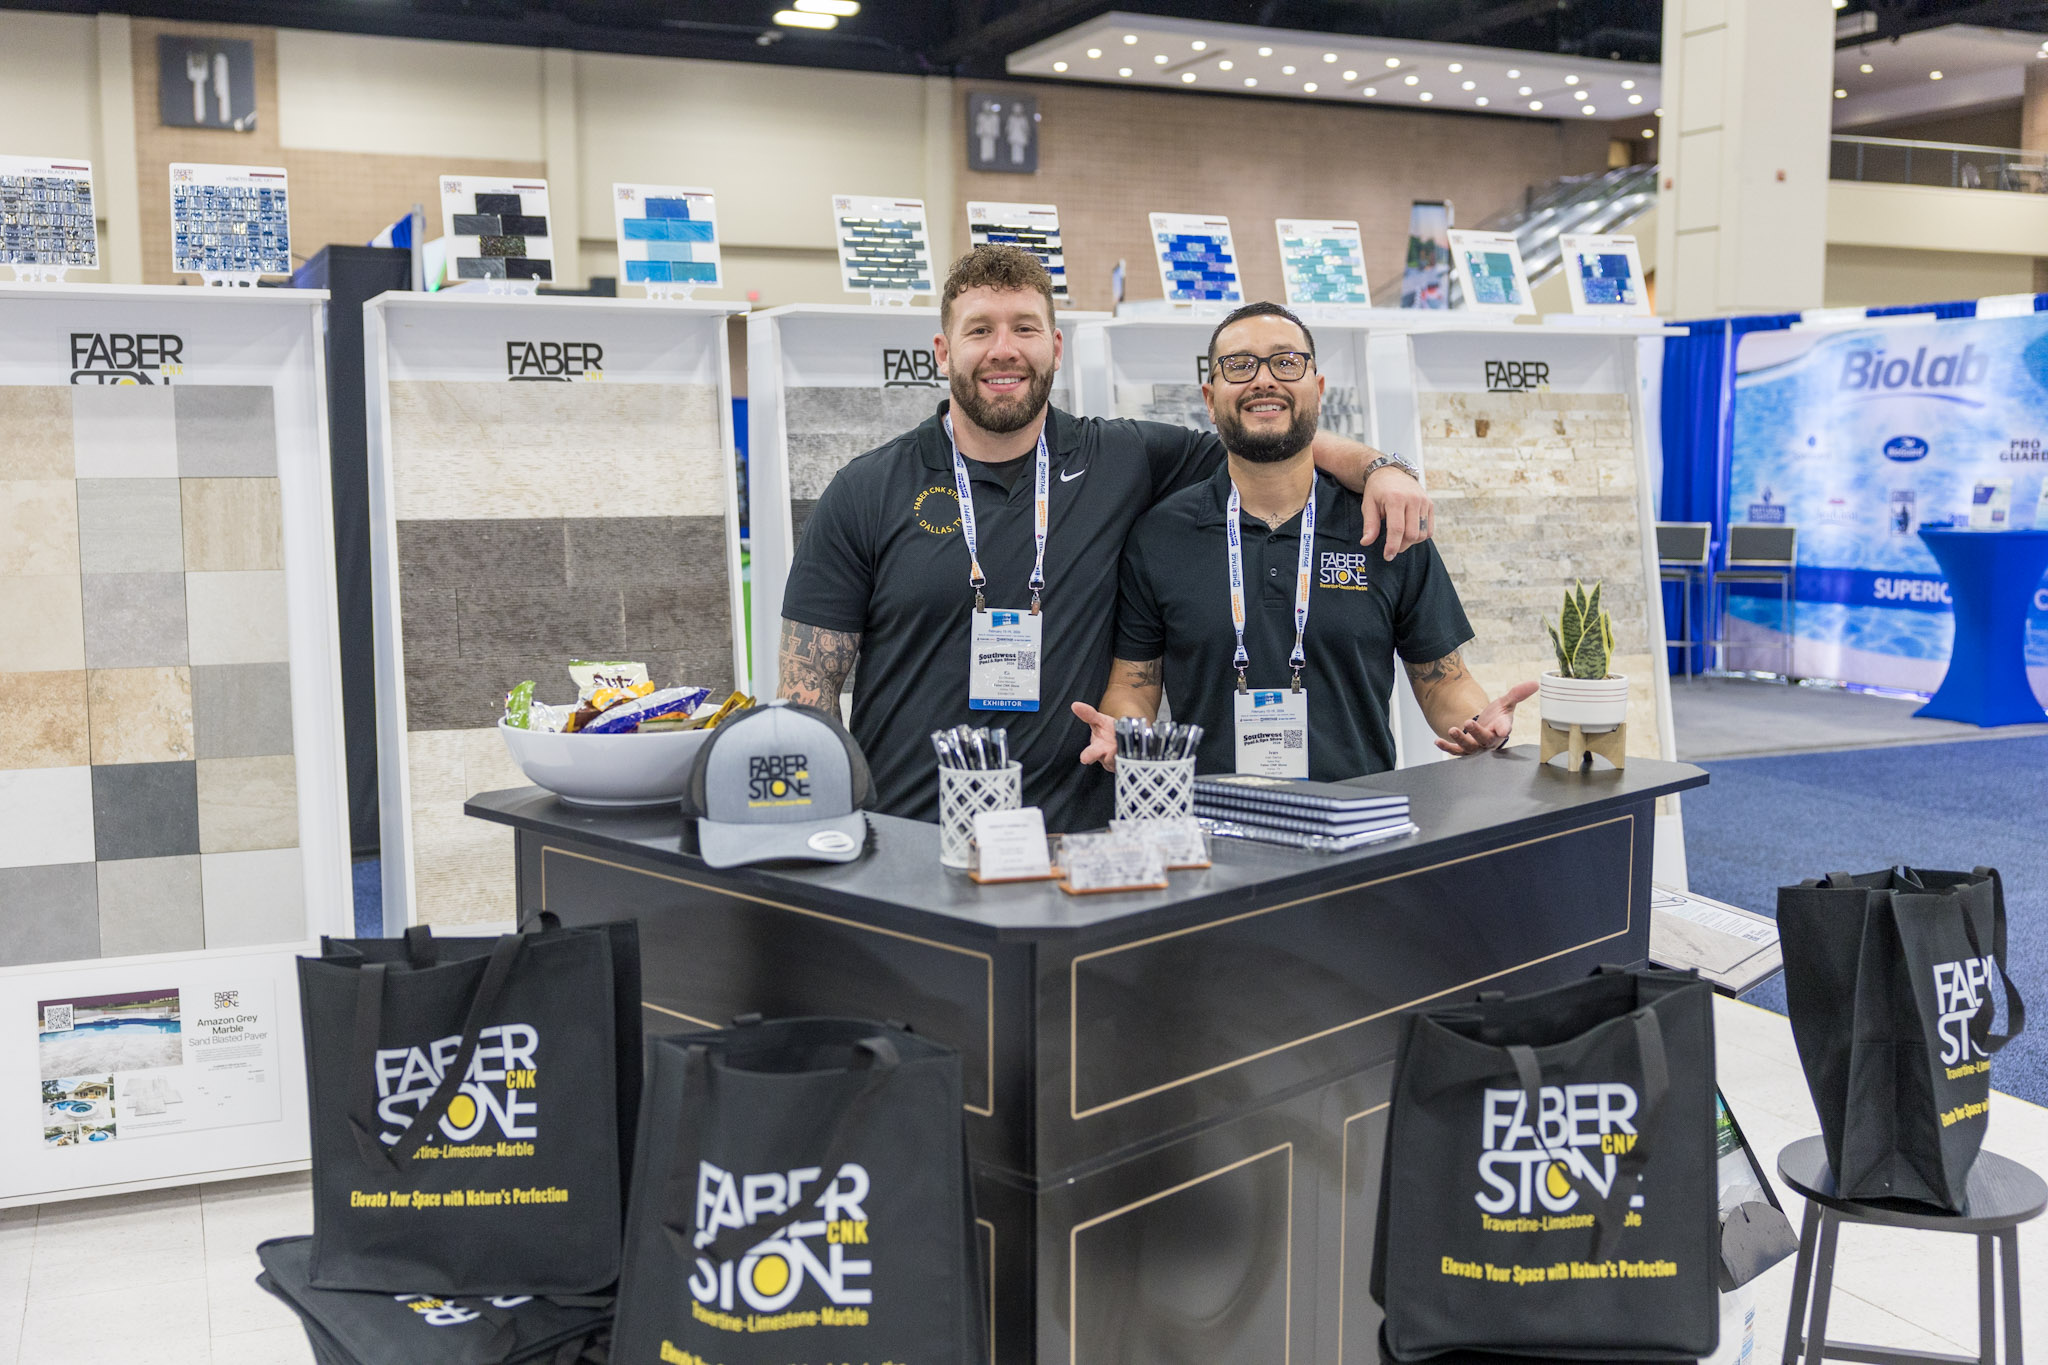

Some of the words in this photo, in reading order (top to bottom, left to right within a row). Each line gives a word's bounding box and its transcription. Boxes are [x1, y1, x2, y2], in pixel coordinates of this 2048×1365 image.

[71, 333, 183, 369] FABER
[507, 341, 603, 375] FABER
[161, 365, 184, 375] CNK
[1485, 360, 1549, 388] FABER
[2010, 440, 2040, 449] PRO
[913, 490, 930, 510] FABER
[929, 486, 947, 494] CNK
[963, 504, 972, 524] SUPPLY
[919, 519, 956, 534] DALLAS,
[1320, 552, 1366, 568] FABER
[1320, 567, 1368, 585] STONE
[979, 652, 1017, 660] Southwest
[1243, 733, 1282, 741] Southwest
[749, 754, 808, 778] FABER
[748, 778, 811, 799] STONE
[214, 990, 239, 1000] FABER
[214, 999, 240, 1009] STONE
[197, 1017, 235, 1027] Amazon
[236, 1014, 258, 1023] Grey
[212, 1025, 244, 1034] Marble
[188, 1037, 211, 1047] Sand
[212, 1034, 243, 1044] Blasted
[244, 1032, 268, 1041] Paver
[505, 1069, 537, 1089] CNK
[1482, 1083, 1638, 1151] FABER
[351, 1190, 388, 1208] Elevate
[389, 1190, 411, 1207] Your
[411, 1189, 441, 1210] Space
[443, 1190, 465, 1206] with
[466, 1188, 511, 1206] Nature's
[512, 1186, 569, 1204] Perfection
[826, 1220, 869, 1244] CNK
[1441, 1255, 1483, 1280] Elevate
[1485, 1262, 1512, 1282] Your
[1512, 1264, 1545, 1286] Space
[1547, 1262, 1569, 1281] with
[1570, 1260, 1618, 1280] Nature's
[1619, 1259, 1678, 1278] Perfection
